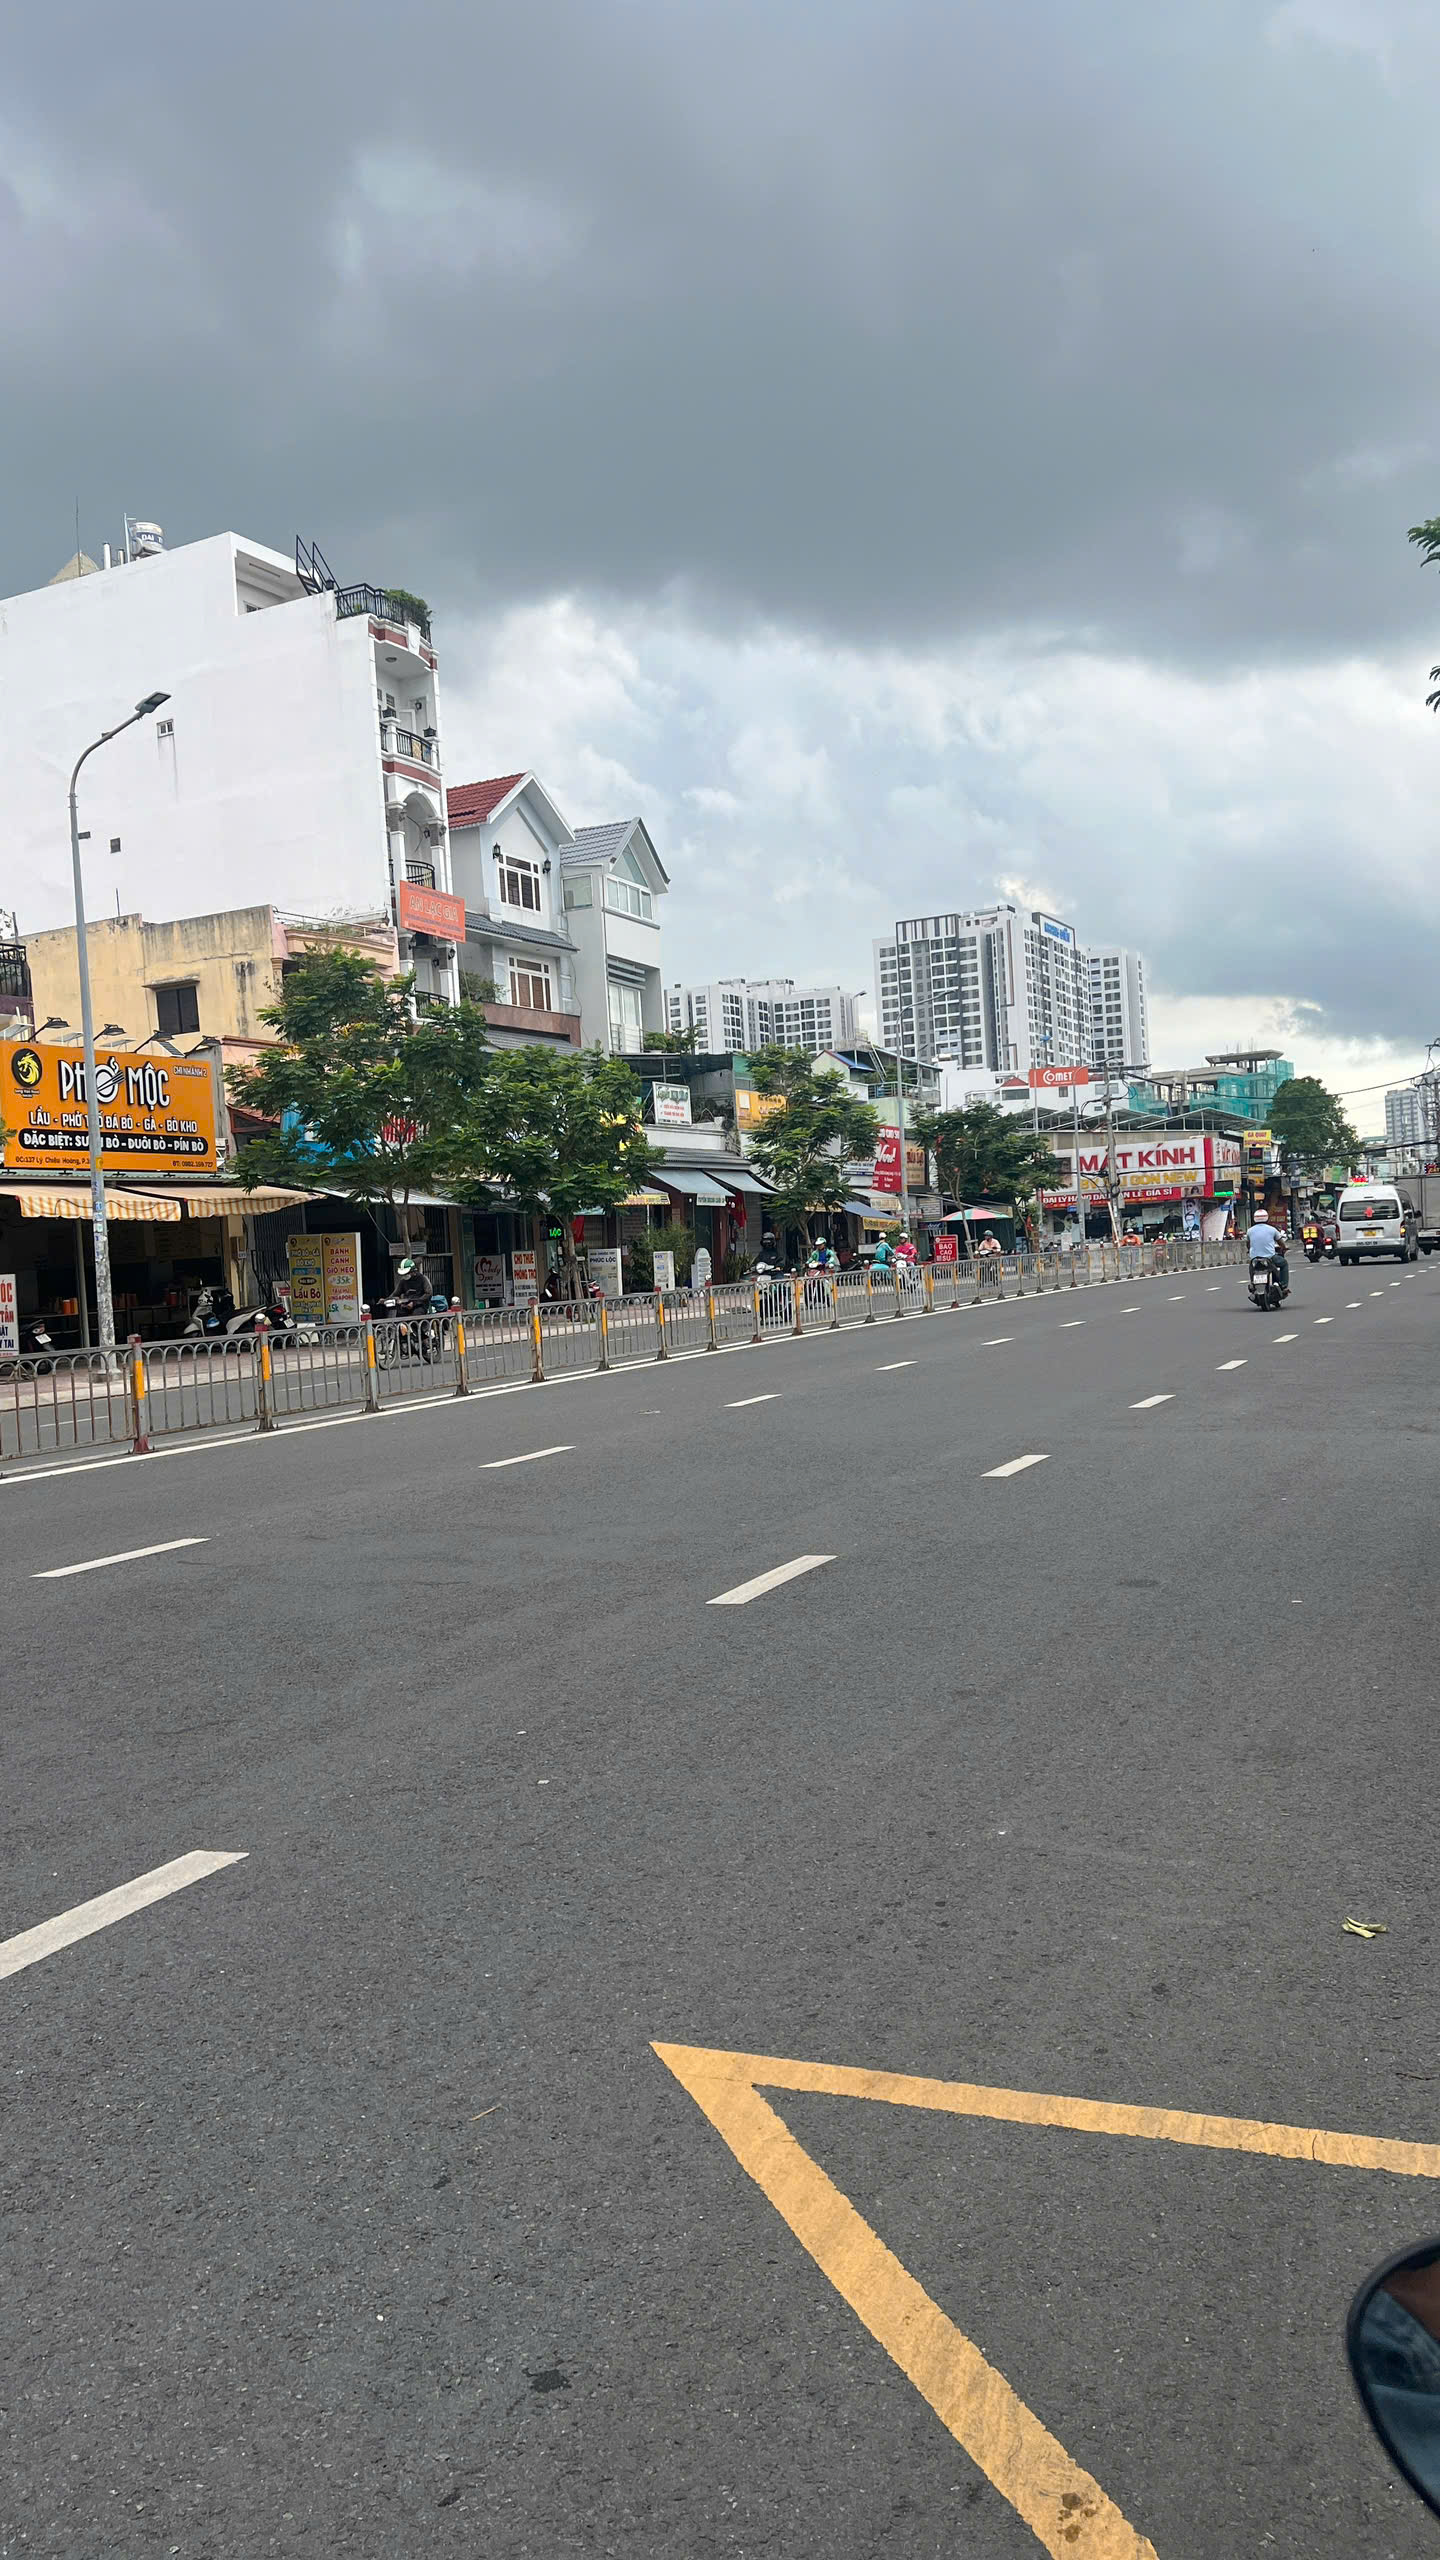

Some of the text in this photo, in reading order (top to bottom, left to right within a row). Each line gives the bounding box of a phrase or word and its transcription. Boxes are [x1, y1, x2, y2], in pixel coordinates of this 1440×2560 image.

[203, 1068, 208, 1078] 2
[1042, 1069, 1073, 1085] COMET
[126, 1061, 171, 1111] MỘC
[83, 1110, 104, 1129] TỐ
[105, 1113, 119, 1129] ĐÁ
[120, 1114, 134, 1130] BÒ
[143, 1115, 157, 1131] GÀ
[166, 1116, 179, 1132] BÒ
[180, 1119, 198, 1133] KHO
[23, 1130, 47, 1148] ĐẶC
[48, 1131, 73, 1149] BIỆT:
[105, 1134, 120, 1149] BÒ
[127, 1136, 151, 1150] ĐUÔI
[153, 1136, 166, 1150] BÒ
[174, 1137, 189, 1151] PÍN
[191, 1138, 204, 1152] BÒ
[1138, 1143, 1196, 1168] KÍNH
[1163, 1171, 1199, 1183] NEW
[605, 1255, 617, 1263] LỘC
[340, 1266, 355, 1274] HEO
